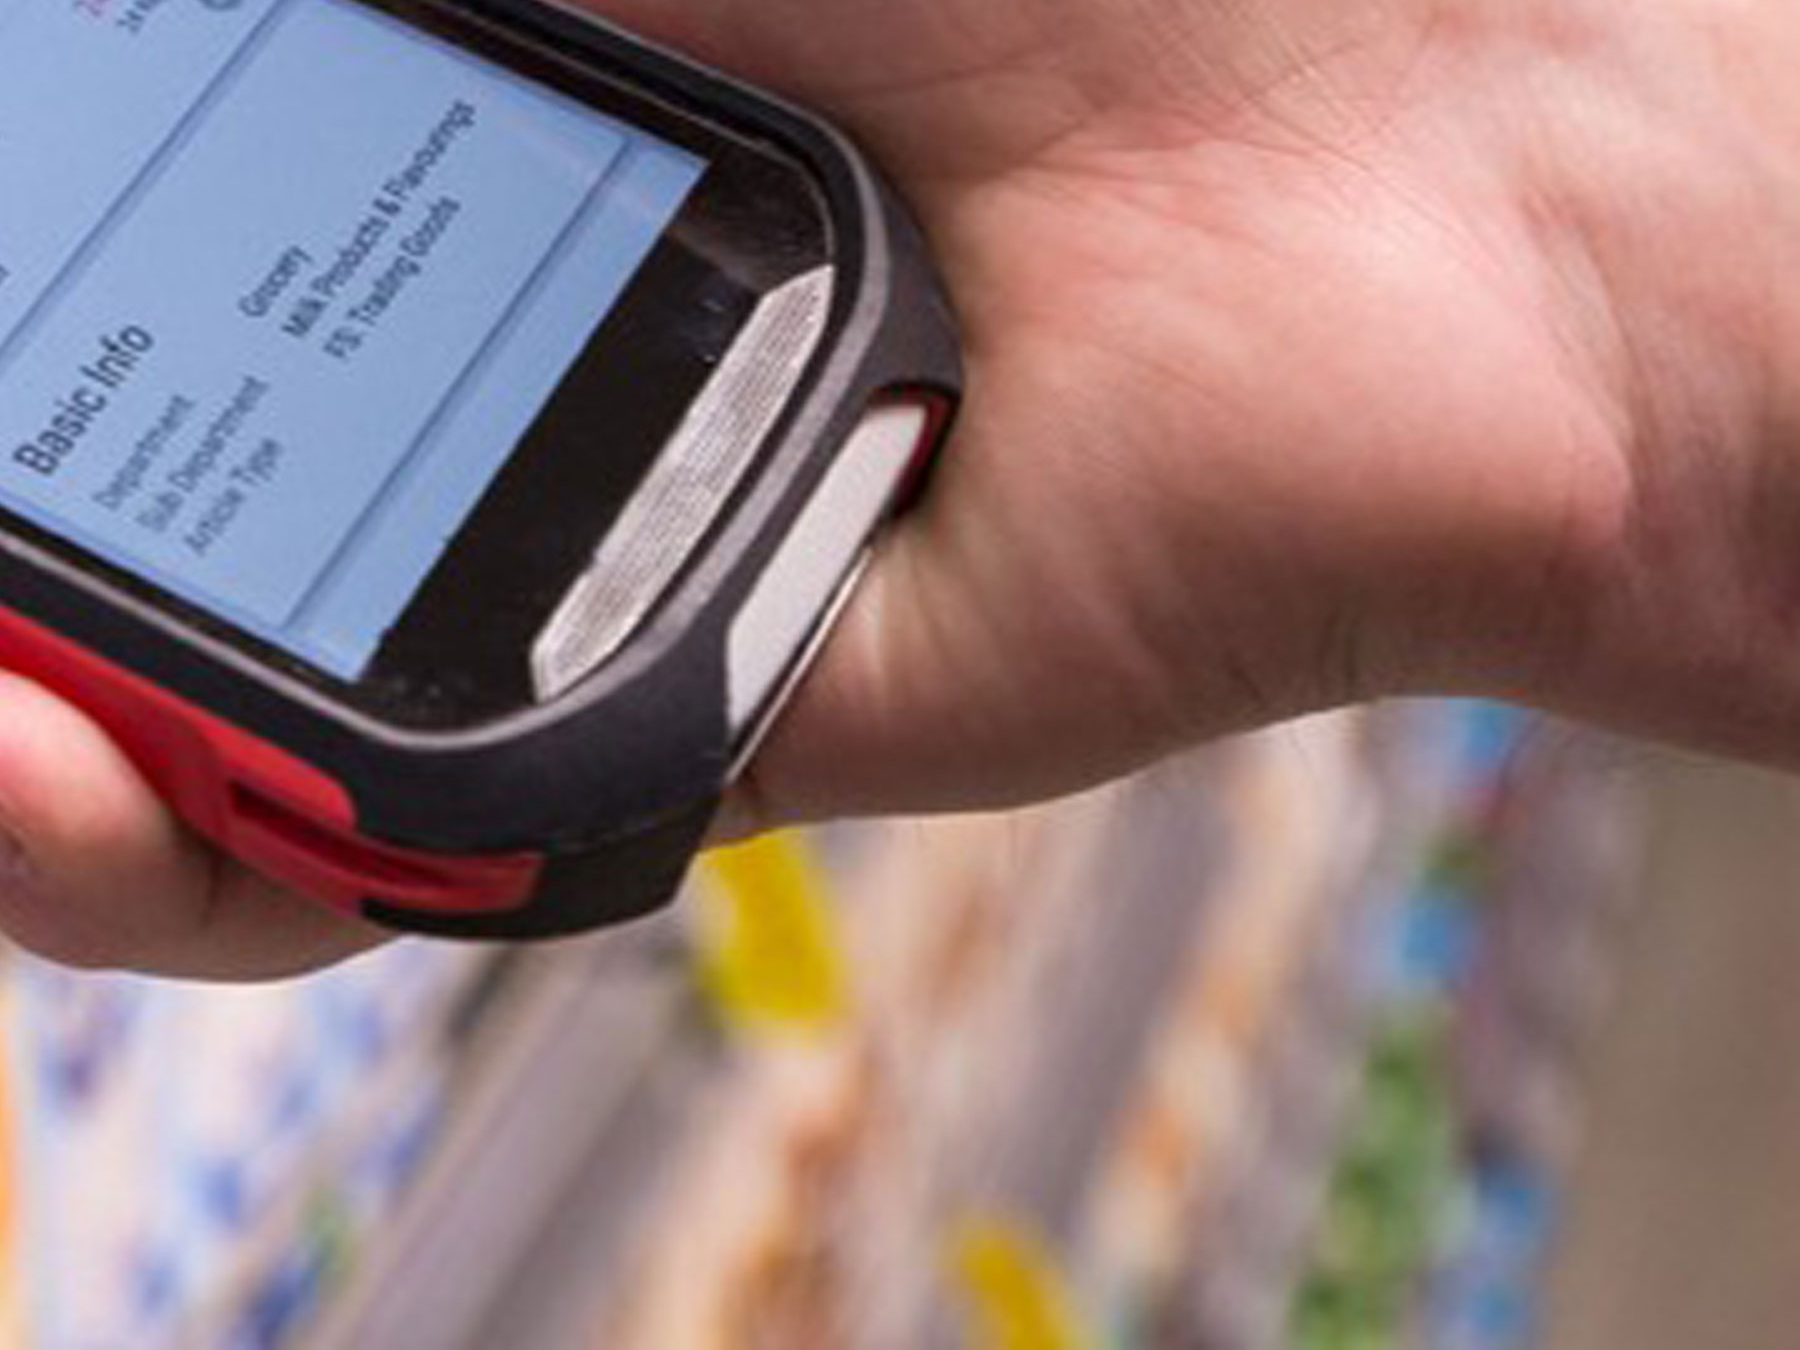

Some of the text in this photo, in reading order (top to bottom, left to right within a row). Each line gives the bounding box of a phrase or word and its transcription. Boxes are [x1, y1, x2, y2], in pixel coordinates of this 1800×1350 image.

[12, 324, 153, 475] Basic Info
[92, 245, 312, 509] Department Grocery
[136, 490, 184, 532] Sub
[167, 375, 268, 492] Department
[280, 297, 327, 337] Milk
[309, 215, 390, 297] Products
[382, 100, 475, 200] Flavourings
[183, 486, 245, 555] Article
[229, 437, 281, 485] Type
[347, 255, 421, 325] Trading
[398, 196, 461, 257] Goods
